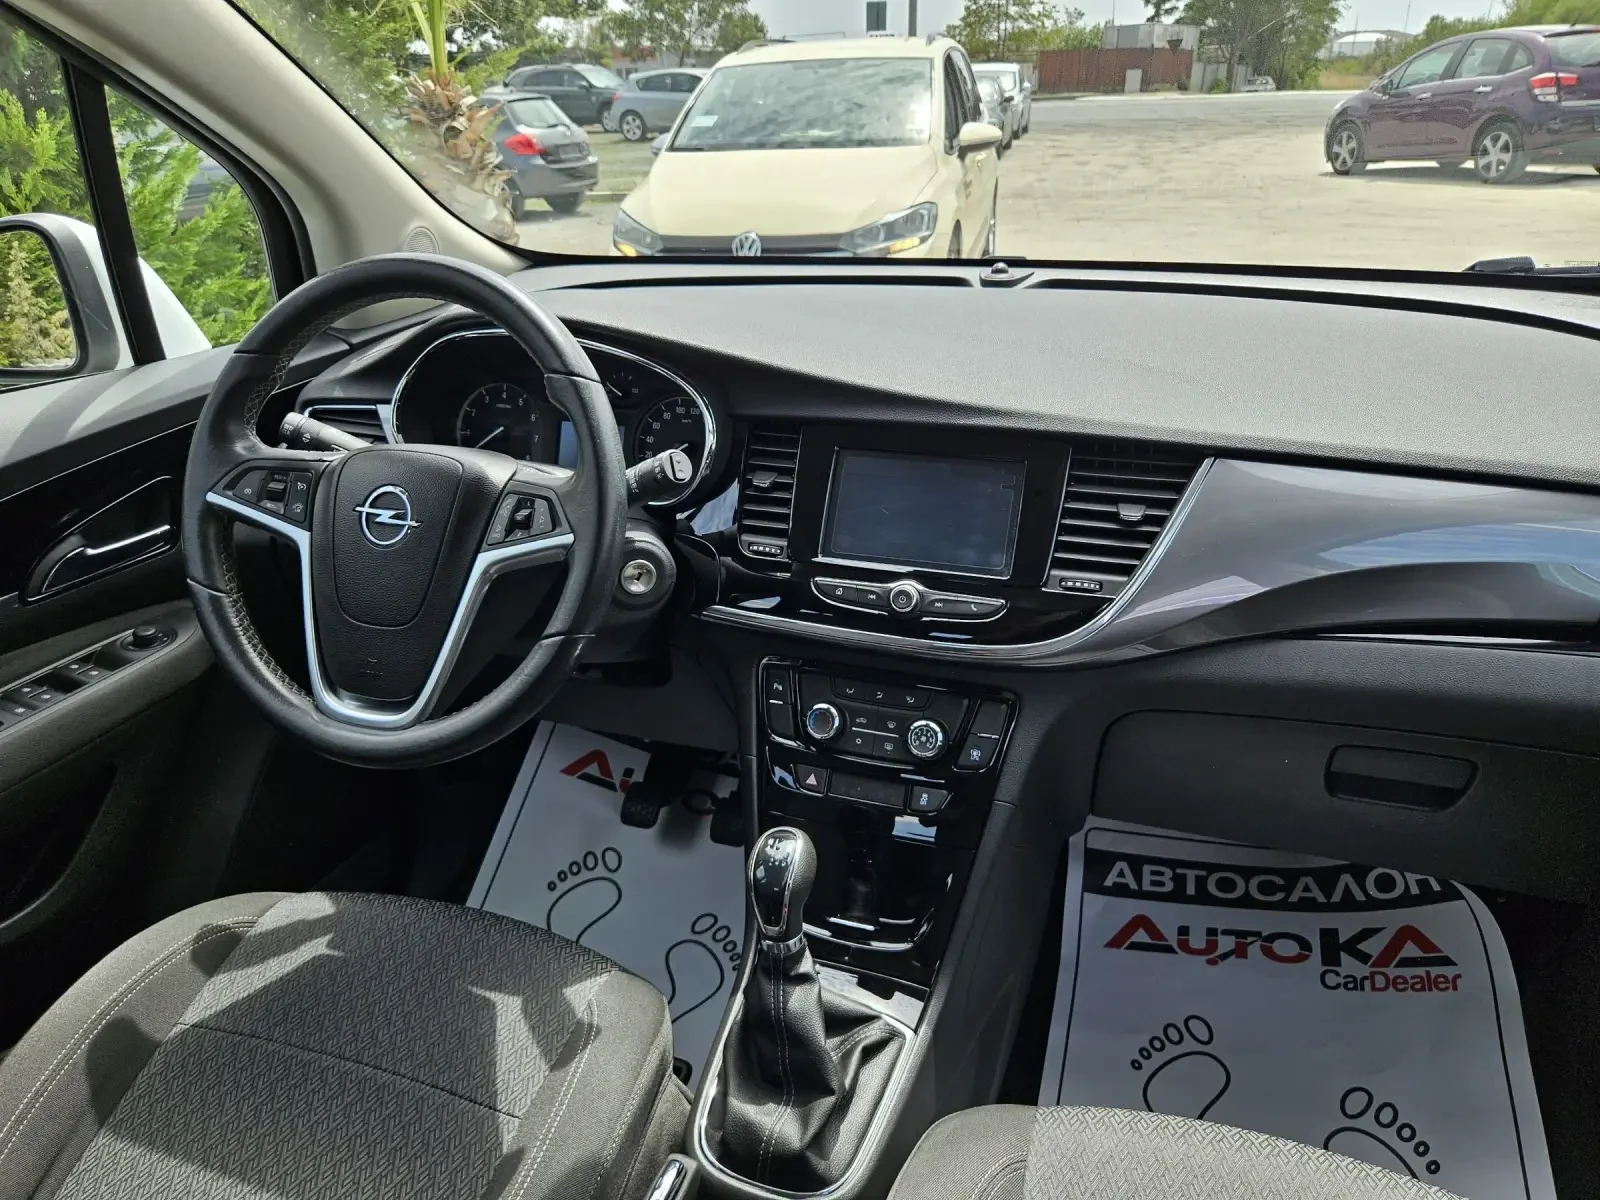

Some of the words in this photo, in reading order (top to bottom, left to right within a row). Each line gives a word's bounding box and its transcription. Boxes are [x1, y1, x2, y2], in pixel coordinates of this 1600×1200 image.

[675, 406, 685, 414] 100
[663, 412, 671, 420] 80
[1319, 968, 1462, 993] CarDealer
